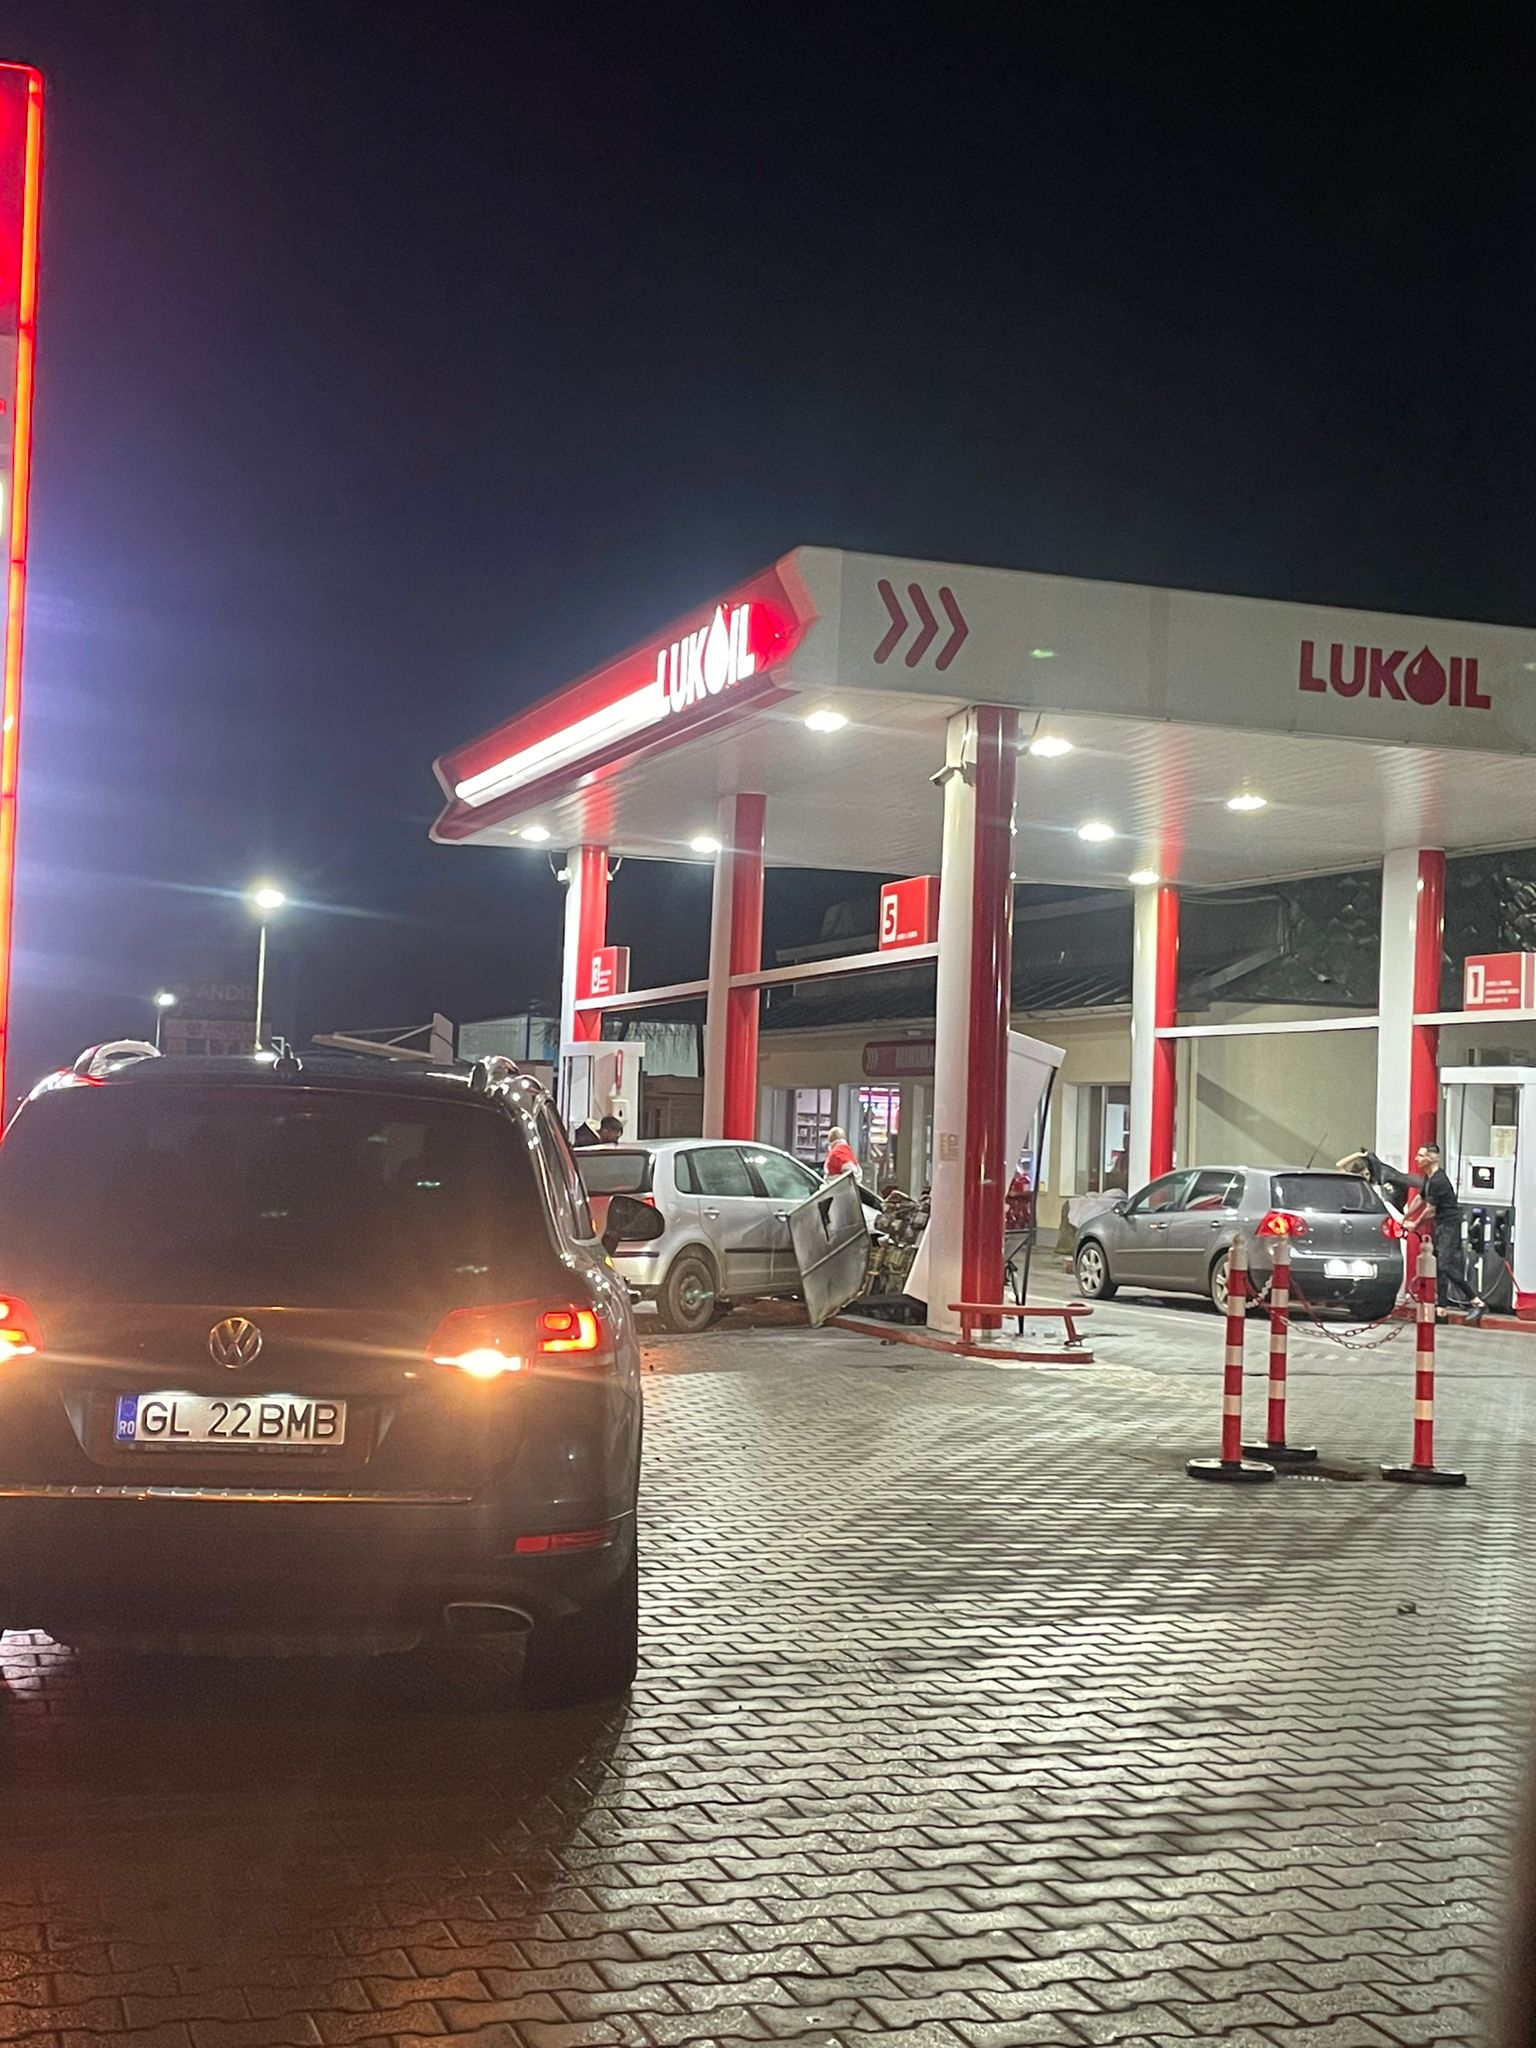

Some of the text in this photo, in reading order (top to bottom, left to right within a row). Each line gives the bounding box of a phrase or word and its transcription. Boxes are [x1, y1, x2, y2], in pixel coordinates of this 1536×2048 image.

[656, 603, 755, 713] LUKOIL
[1299, 640, 1491, 709] LUKOIL
[884, 902, 895, 936] 5
[1473, 1256, 1484, 1293] 1
[119, 1421, 136, 1435] RO
[142, 1401, 190, 1438] GL
